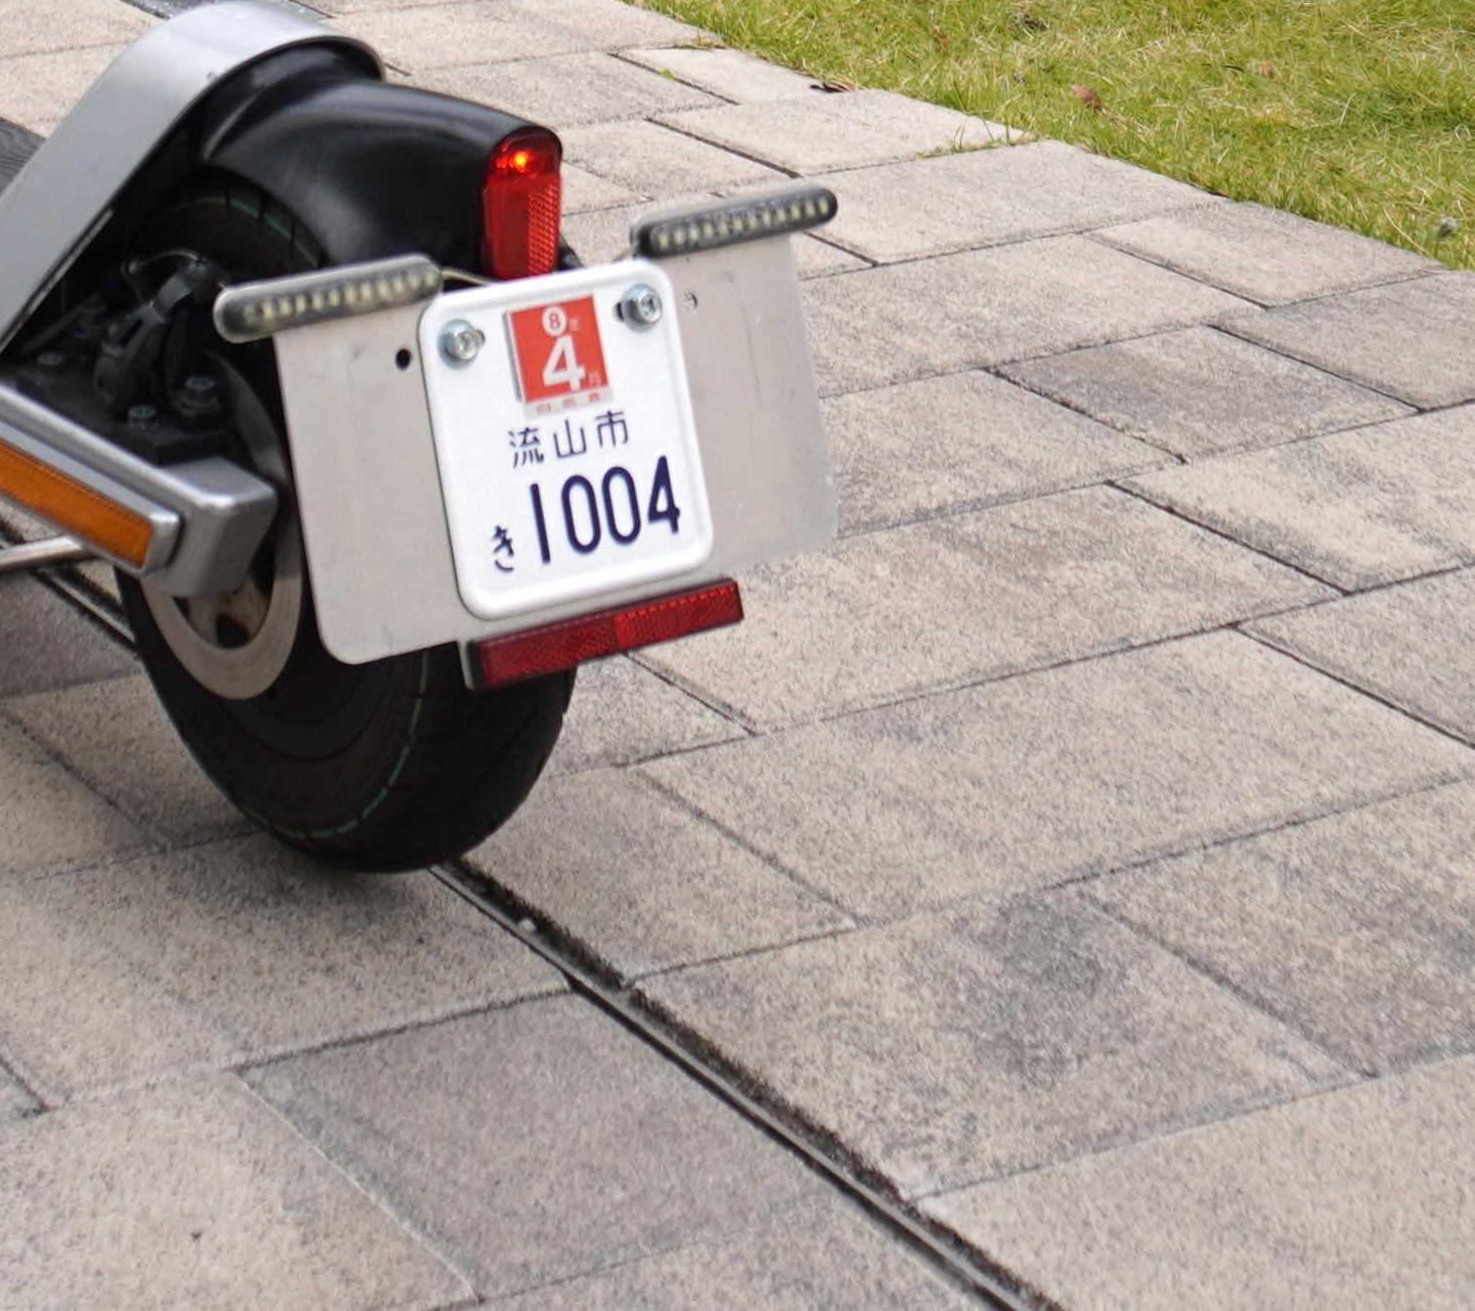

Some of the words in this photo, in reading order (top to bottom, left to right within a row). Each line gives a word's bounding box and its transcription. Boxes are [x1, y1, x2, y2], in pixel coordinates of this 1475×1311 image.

[542, 334, 586, 392] 4
[508, 410, 629, 468] 流山市
[529, 455, 680, 565] 1004
